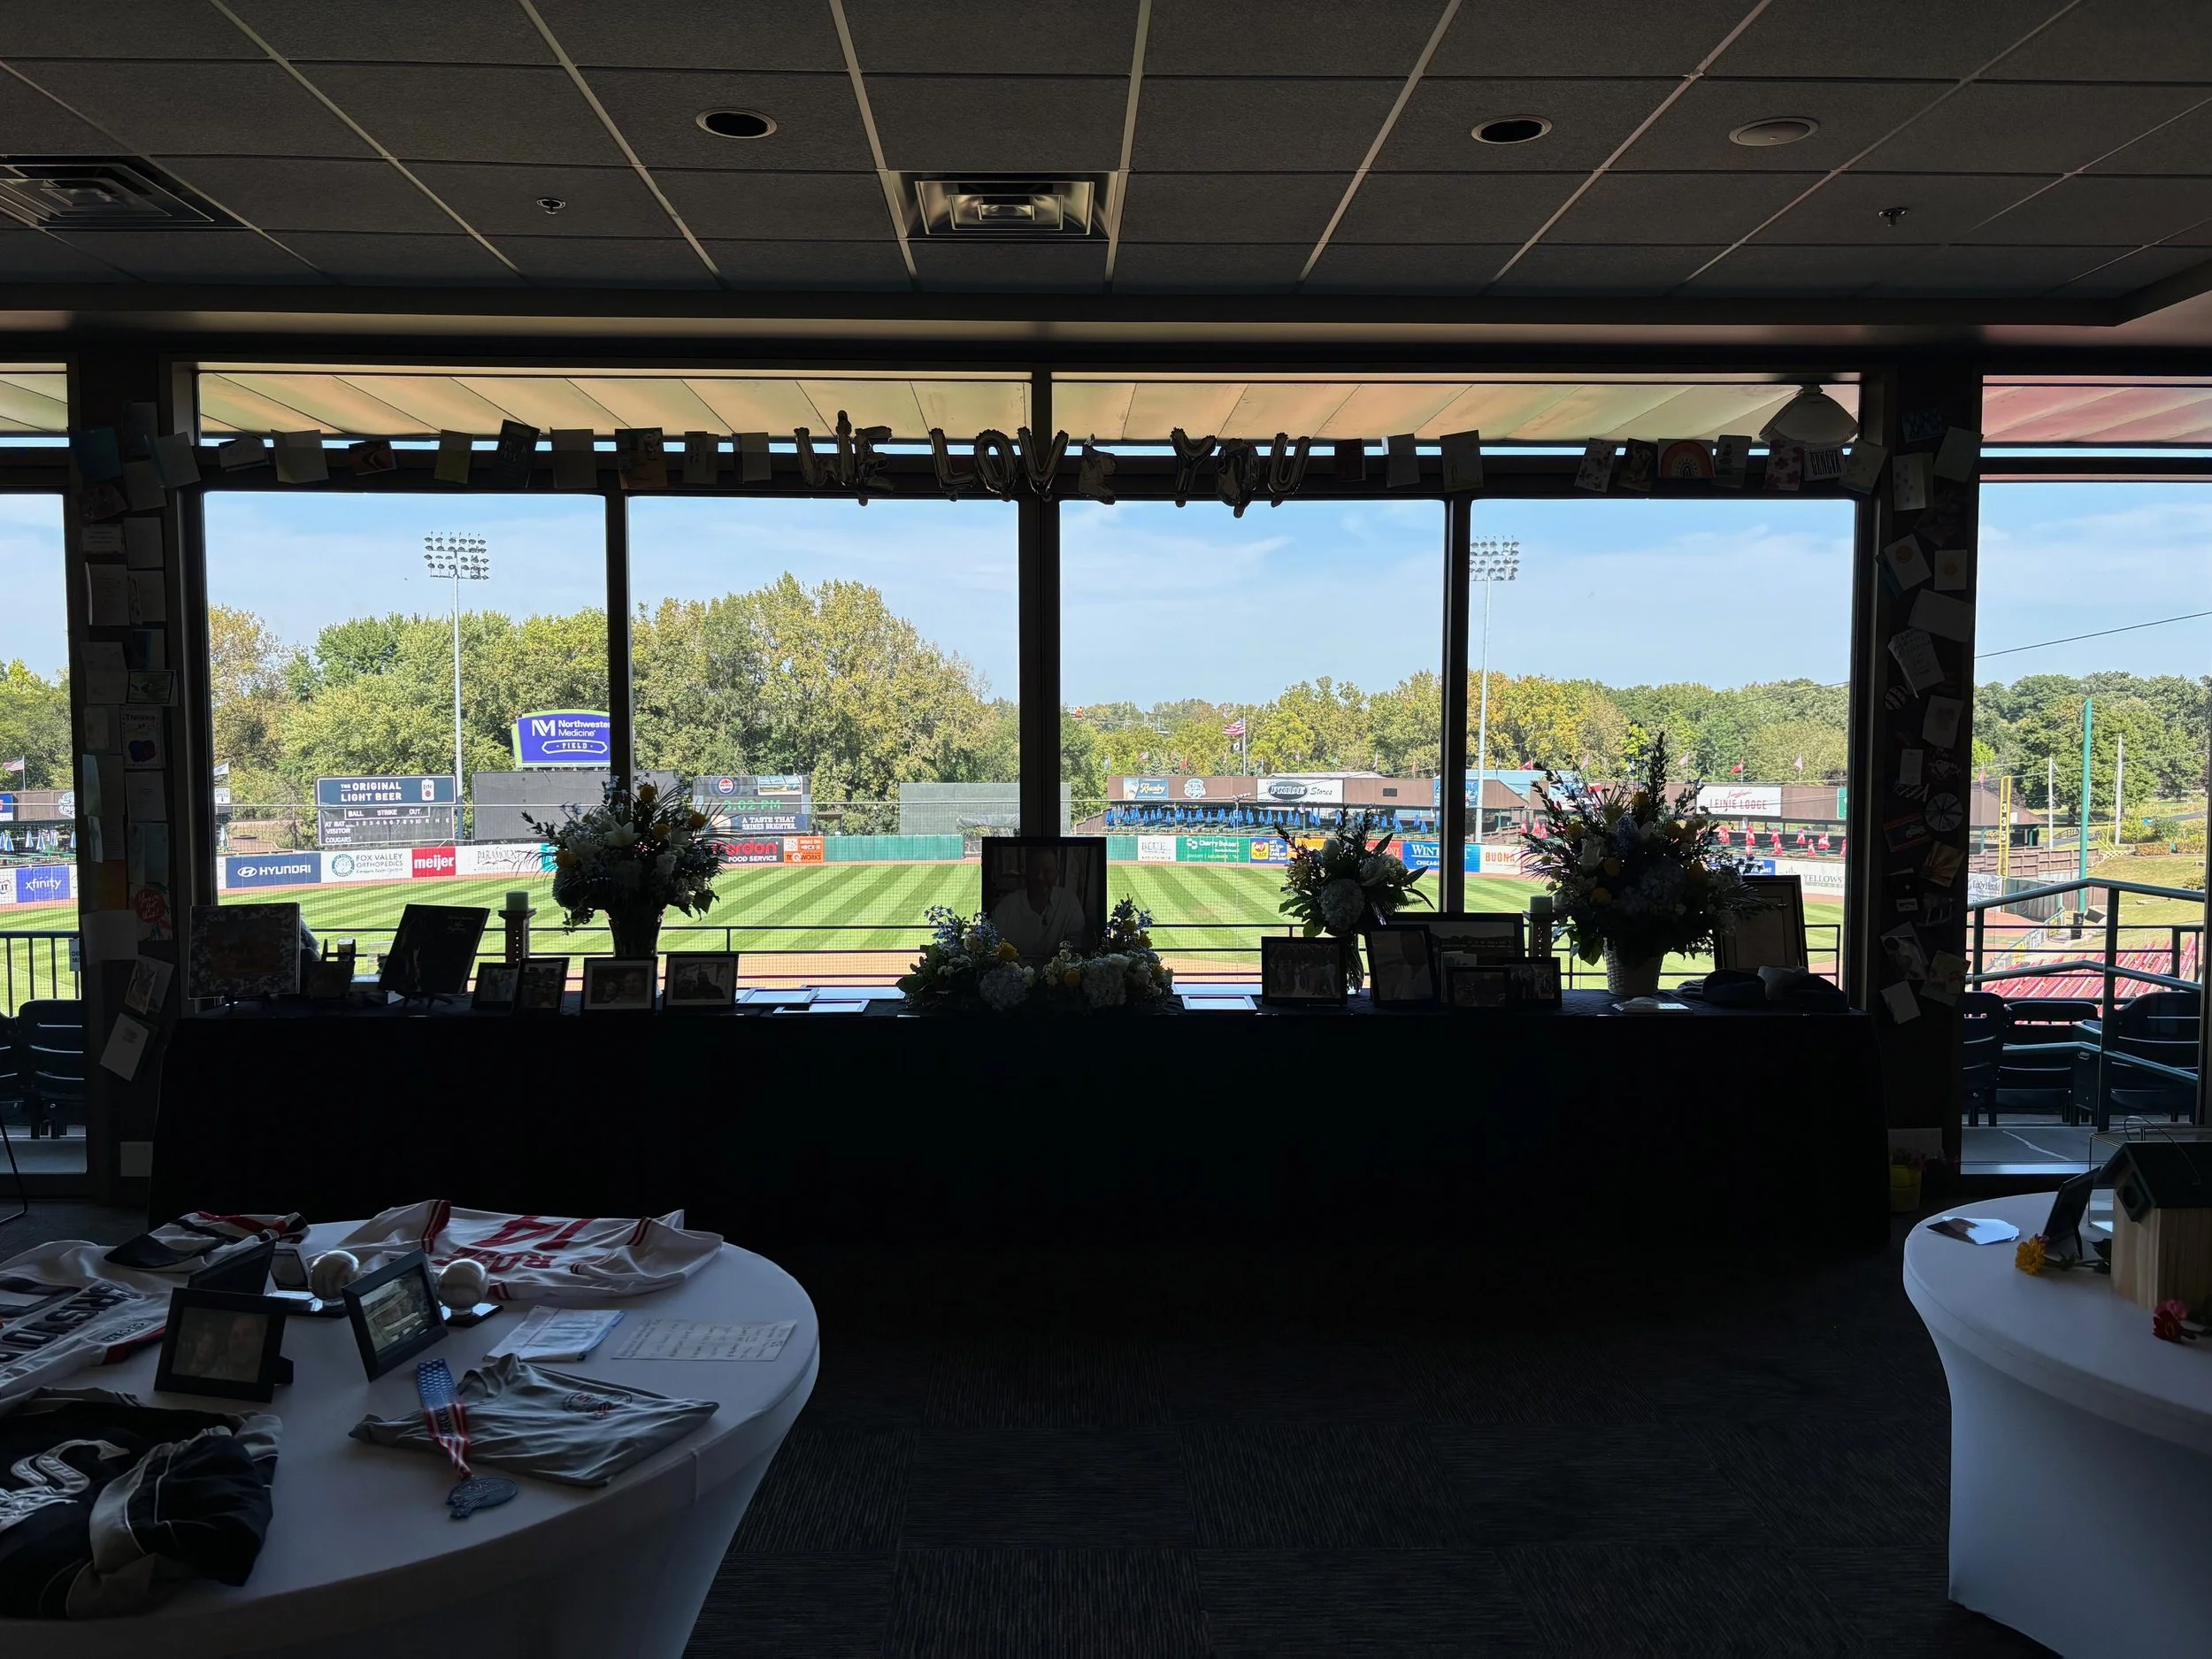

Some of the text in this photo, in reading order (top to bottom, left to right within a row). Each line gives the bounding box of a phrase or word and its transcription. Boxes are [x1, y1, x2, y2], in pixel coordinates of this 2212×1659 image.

[795, 411, 894, 506] WE
[1171, 426, 1312, 518] YOU
[352, 781, 402, 791] ORIGINAL
[1310, 787, 1333, 795] Stores
[341, 793, 403, 802] LIGHT BEER
[761, 800, 780, 810] PM
[1740, 800, 1767, 810] LODGE
[1485, 850, 1516, 863] BUONA
[413, 855, 455, 871] meijer
[259, 864, 311, 875] HYUNDAI
[25, 875, 62, 891] xfinity
